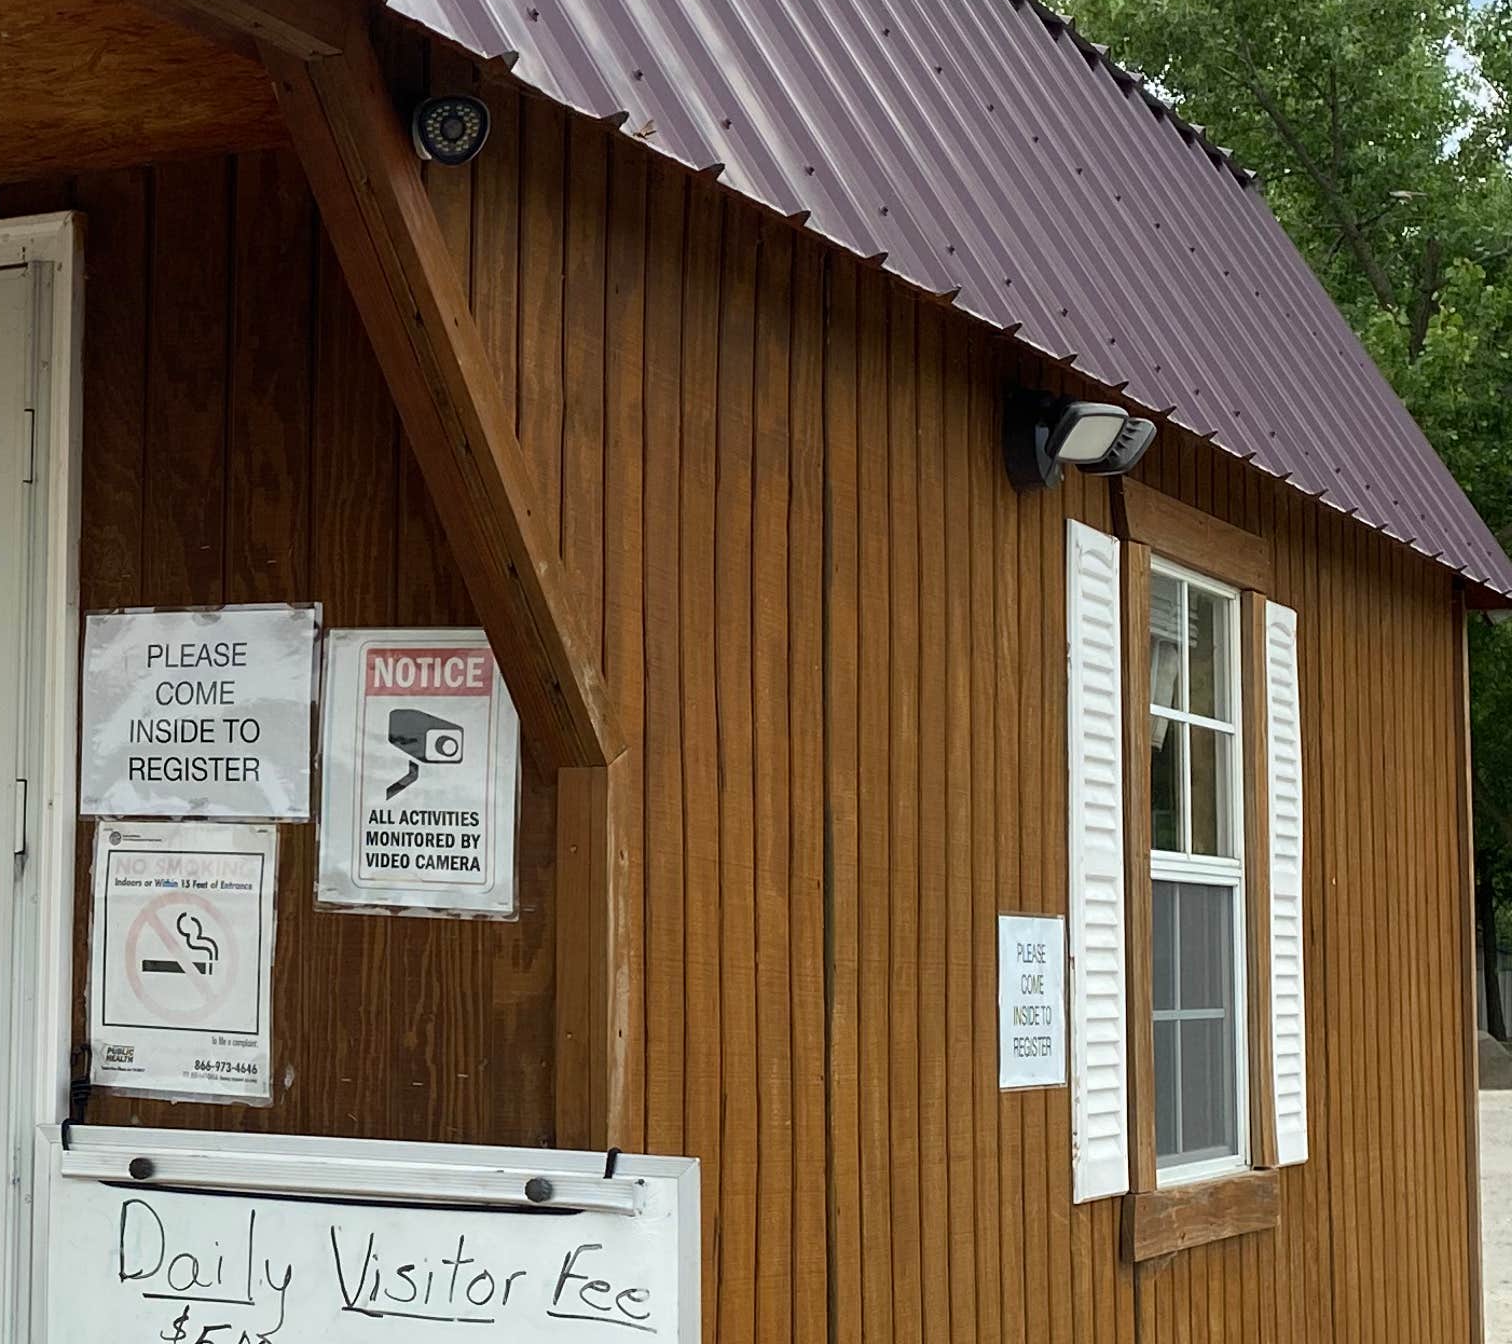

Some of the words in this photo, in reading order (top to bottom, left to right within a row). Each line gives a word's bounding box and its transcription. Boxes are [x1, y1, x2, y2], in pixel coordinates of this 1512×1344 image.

[146, 641, 249, 669] PLEASE
[372, 656, 486, 690] NOTICE
[154, 680, 236, 707] COME
[129, 718, 216, 745] INSIDE
[228, 718, 261, 745] TO
[128, 755, 261, 783] REGISTER
[368, 809, 396, 828] ALL
[399, 809, 481, 829] ACTIVITIES
[365, 830, 457, 850] MONITORED
[460, 832, 483, 851] BY
[114, 858, 147, 875] NO
[154, 859, 251, 878] SMOKING
[365, 851, 411, 872] VIDEO
[414, 852, 483, 874] CAMERA
[114, 877, 142, 887] Indoors
[144, 879, 153, 887] or
[154, 878, 179, 888] Within
[192, 879, 208, 890] Feet
[210, 880, 219, 890] of
[220, 880, 253, 891] Entrance
[1016, 942, 1047, 964] PLEASE
[1020, 974, 1045, 996] COME
[1013, 1005, 1040, 1026] INSIDE
[1041, 1006, 1053, 1026] TO
[1013, 1036, 1053, 1058] REGISTER
[194, 1059, 259, 1075] 866-973-4646
[118, 1198, 293, 1336] Daily
[330, 1224, 528, 1310] Visitor
[549, 1243, 653, 1320] Fee
